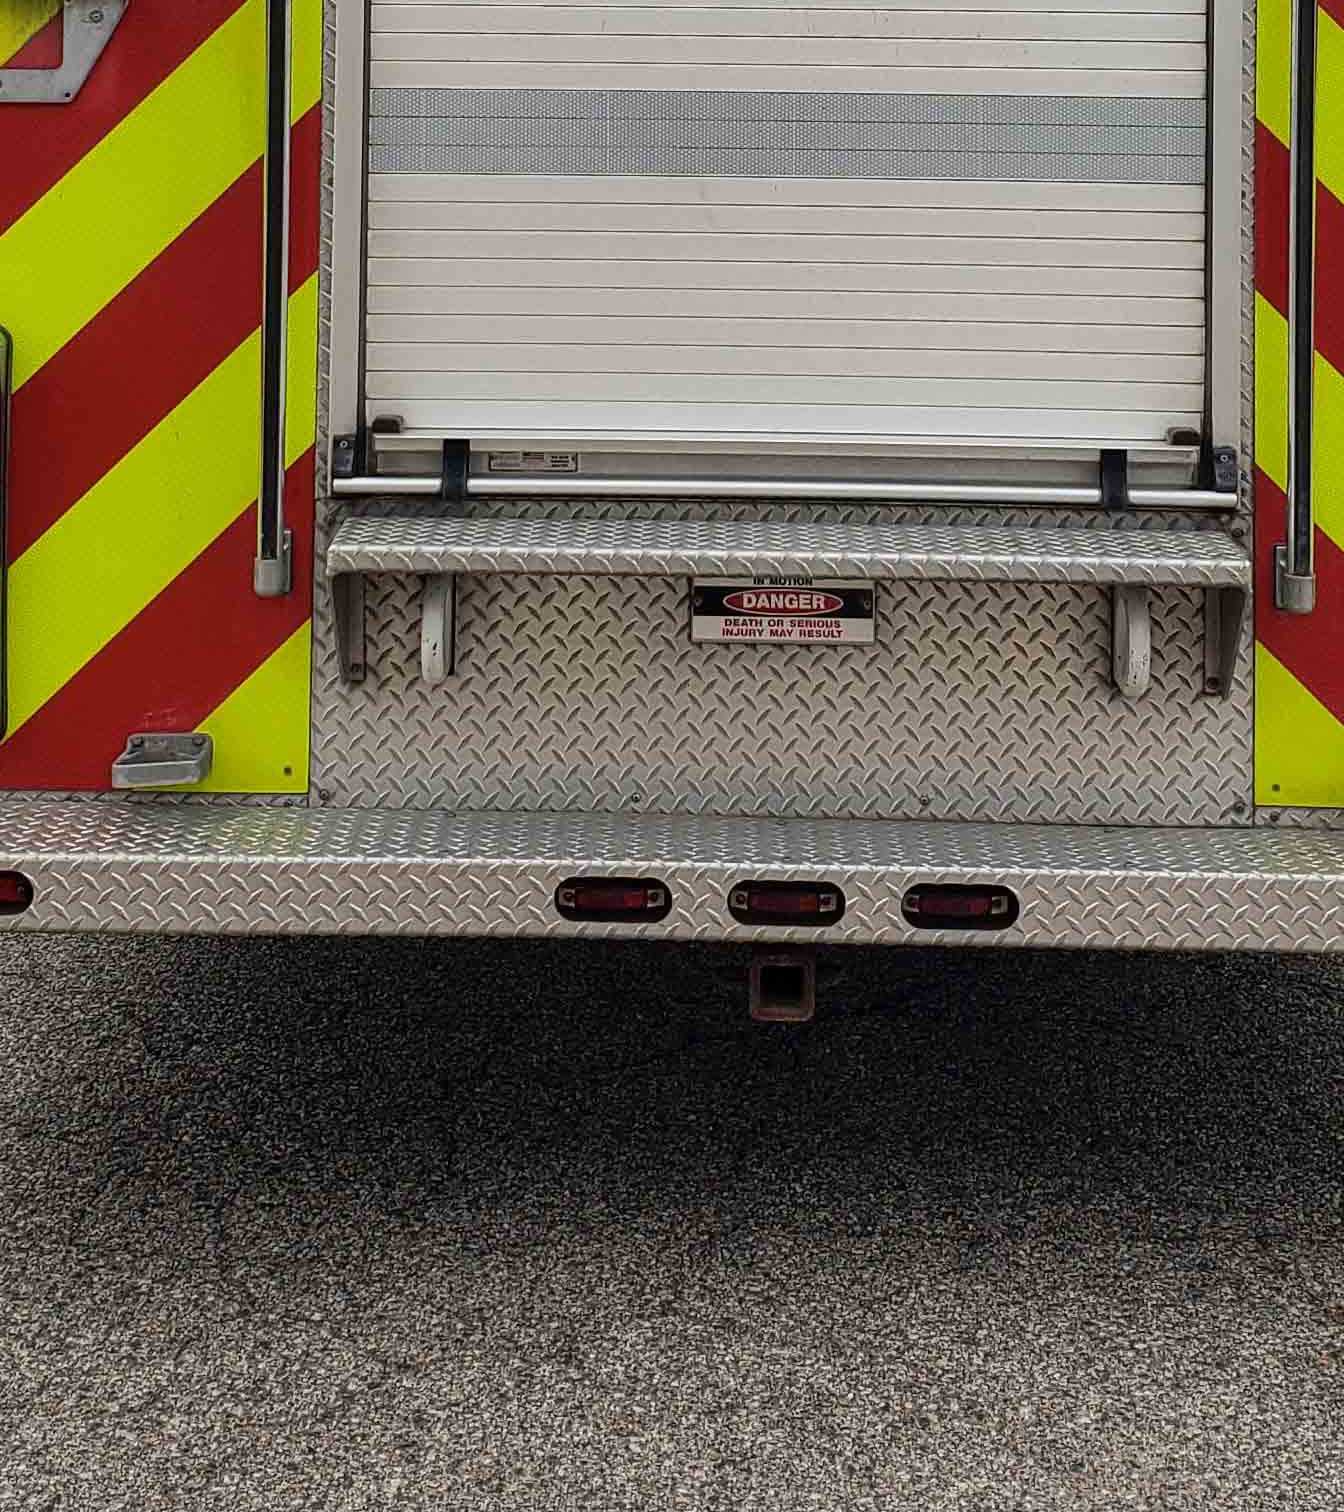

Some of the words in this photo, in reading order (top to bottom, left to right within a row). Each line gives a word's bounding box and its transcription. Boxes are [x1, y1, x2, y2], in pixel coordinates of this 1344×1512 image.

[753, 576, 765, 586] IN
[769, 575, 813, 586] MOTION
[742, 593, 825, 609] DANGER
[724, 618, 763, 627] DEATH
[767, 619, 784, 628] OR
[790, 620, 841, 629] SERIOUS
[722, 628, 765, 637] INJURY
[769, 629, 794, 637] MAY
[799, 630, 844, 638] RESULT
